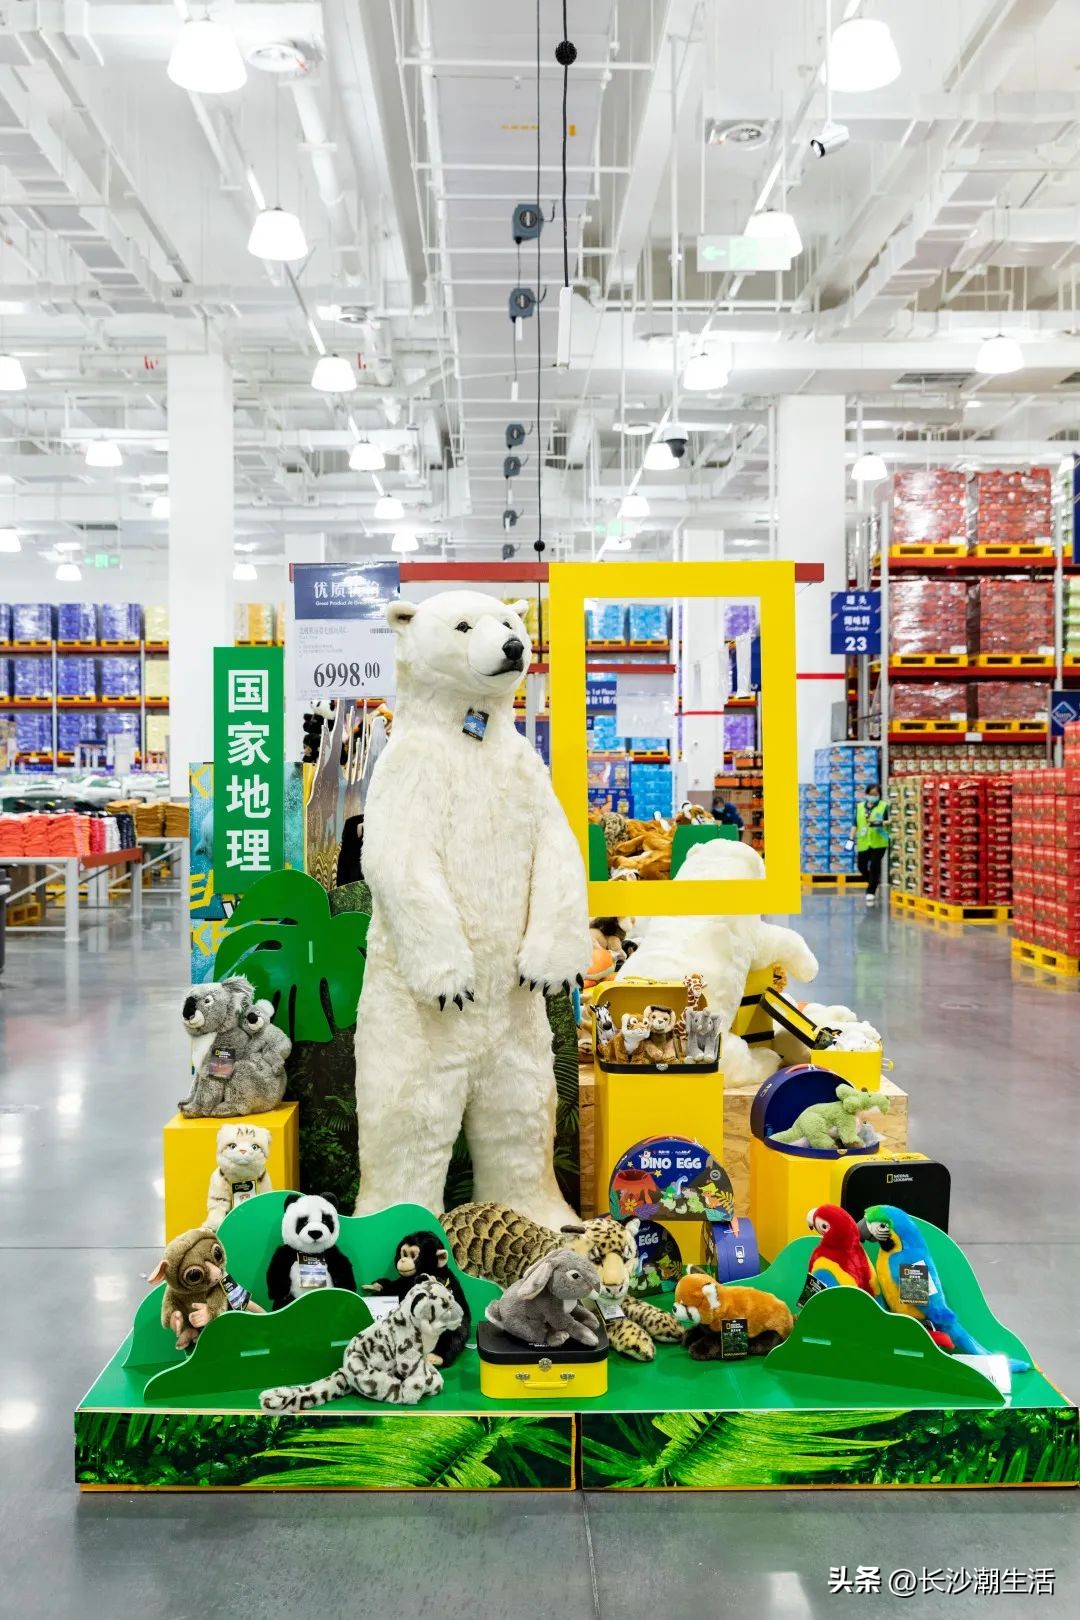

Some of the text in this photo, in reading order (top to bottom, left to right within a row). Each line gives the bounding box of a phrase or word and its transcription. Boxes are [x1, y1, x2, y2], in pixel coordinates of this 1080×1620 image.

[845, 636, 867, 652] 23
[313, 661, 380, 688] 6998.00
[226, 669, 271, 872] 国家地理
[640, 1157, 702, 1169] DINO EGG
[638, 1232, 659, 1247] EGG
